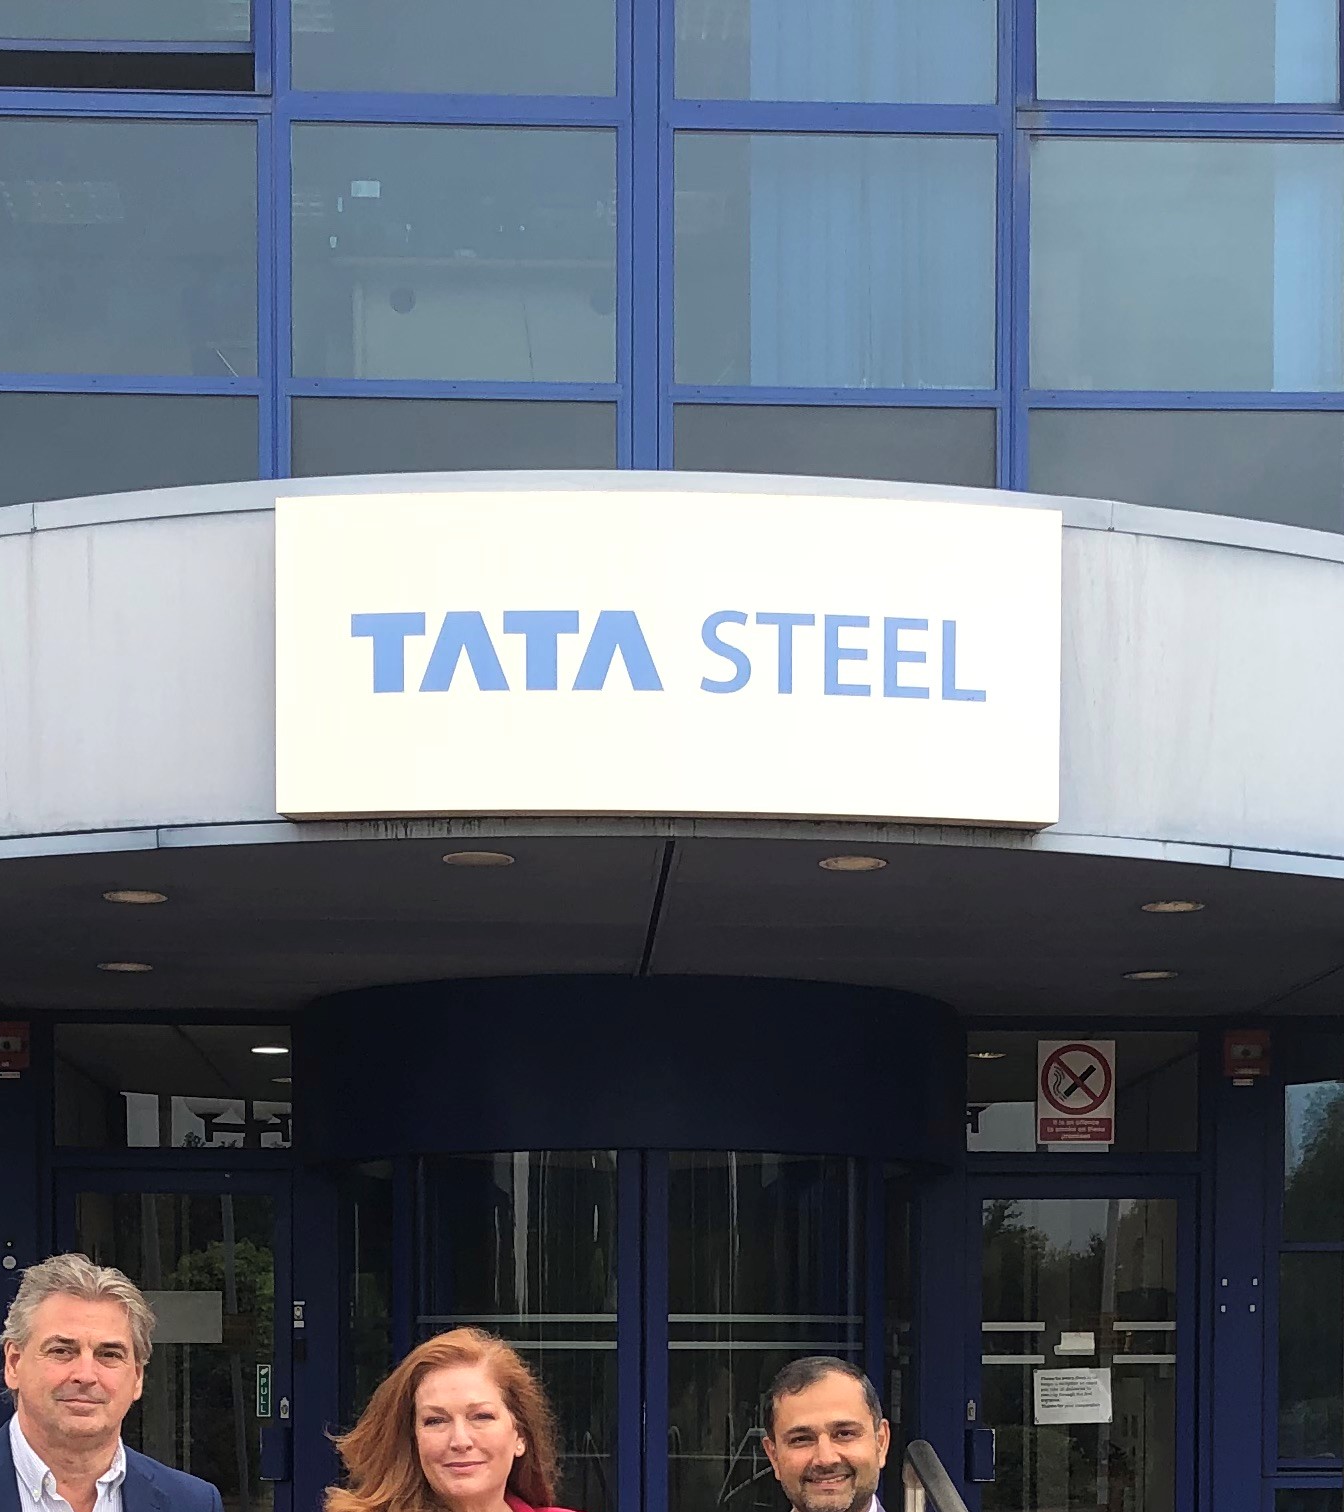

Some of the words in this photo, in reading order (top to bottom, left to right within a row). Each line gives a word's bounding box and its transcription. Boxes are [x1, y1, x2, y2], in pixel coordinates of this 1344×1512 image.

[351, 611, 664, 693] TATA
[700, 610, 986, 702] STEEL
[260, 1377, 268, 1413] PULL
